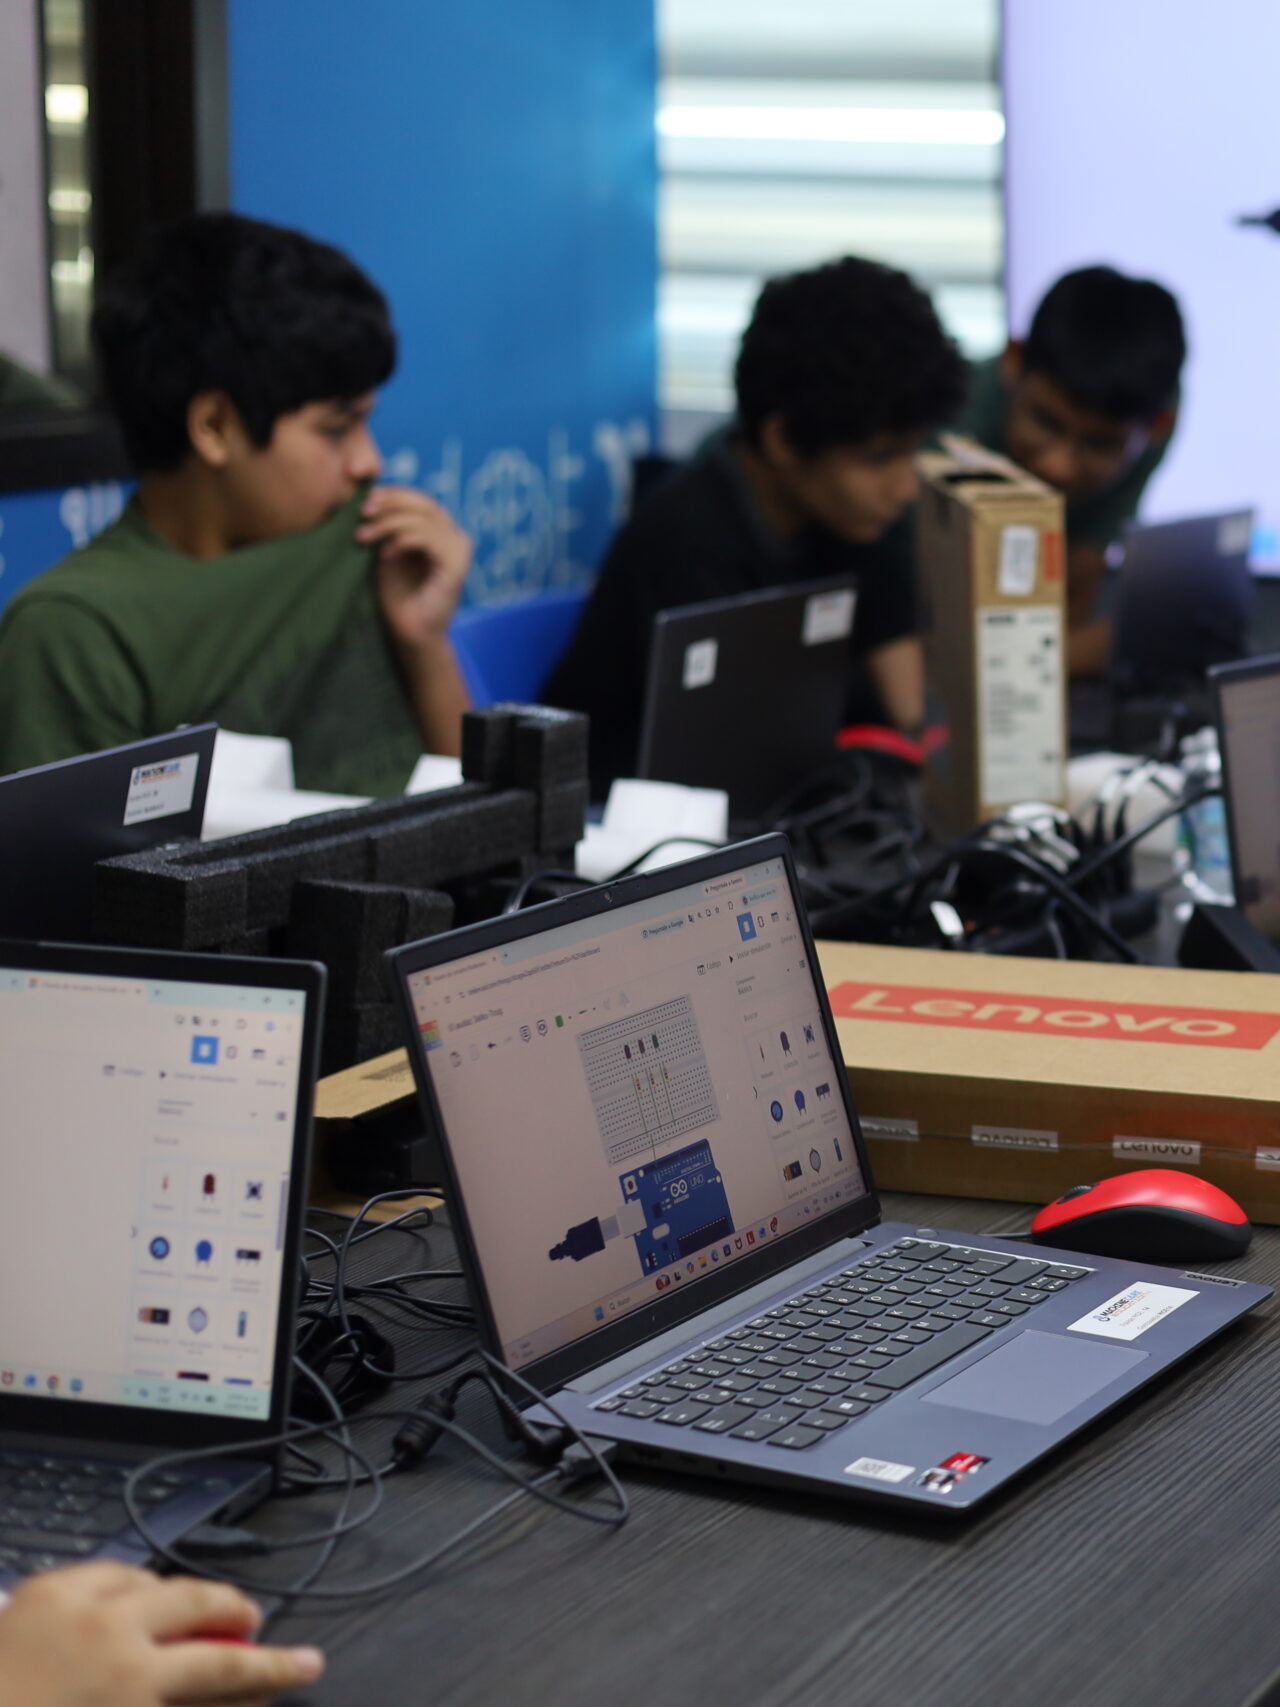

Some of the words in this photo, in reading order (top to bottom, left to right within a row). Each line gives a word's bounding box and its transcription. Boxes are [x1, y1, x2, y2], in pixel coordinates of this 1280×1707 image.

[851, 990, 1237, 1037] Lenovo
[1120, 1142, 1194, 1157] Lenovo
[1186, 1273, 1239, 1287] Lenovo
